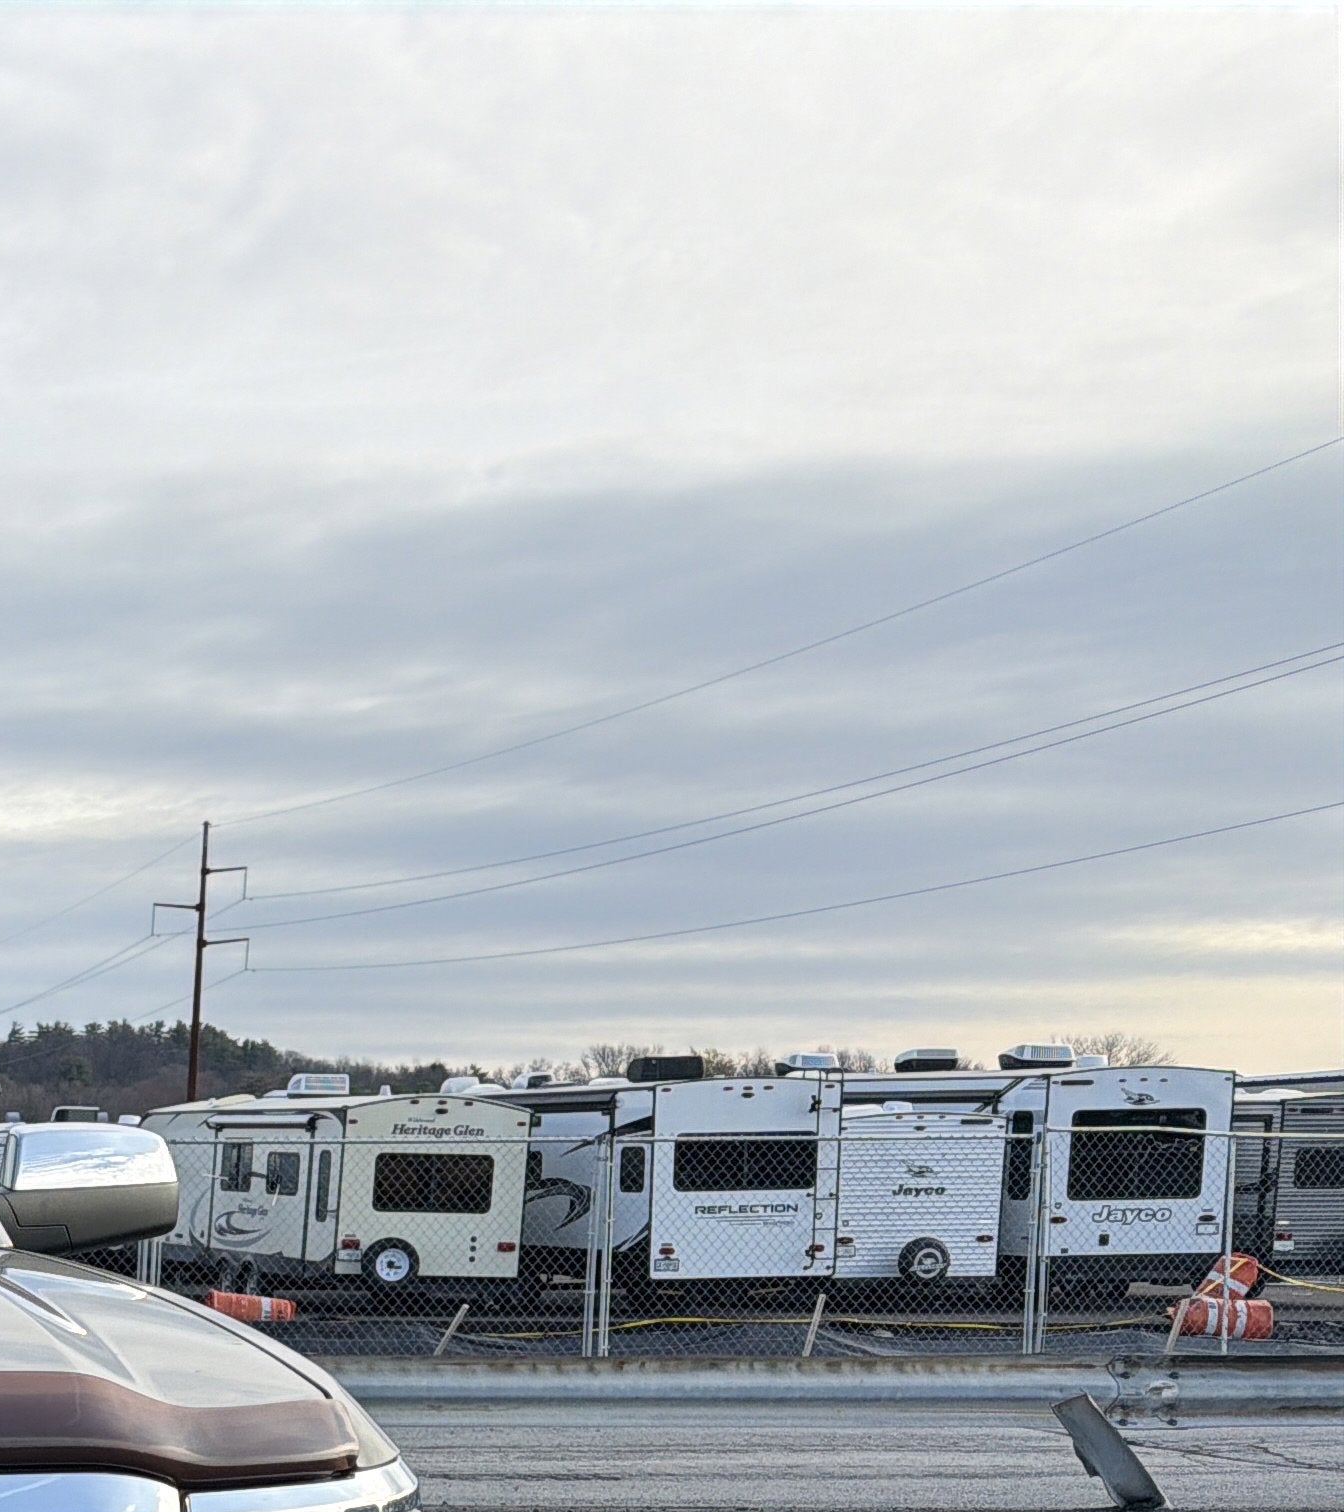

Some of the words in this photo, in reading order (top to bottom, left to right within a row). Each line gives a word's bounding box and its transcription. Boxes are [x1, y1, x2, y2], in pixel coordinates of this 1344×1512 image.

[392, 1123, 452, 1138] Heritage
[453, 1124, 485, 1136] Glen
[892, 1184, 945, 1198] Jayco
[694, 1203, 799, 1215] REFLECTION
[1092, 1204, 1172, 1225] Jayco
